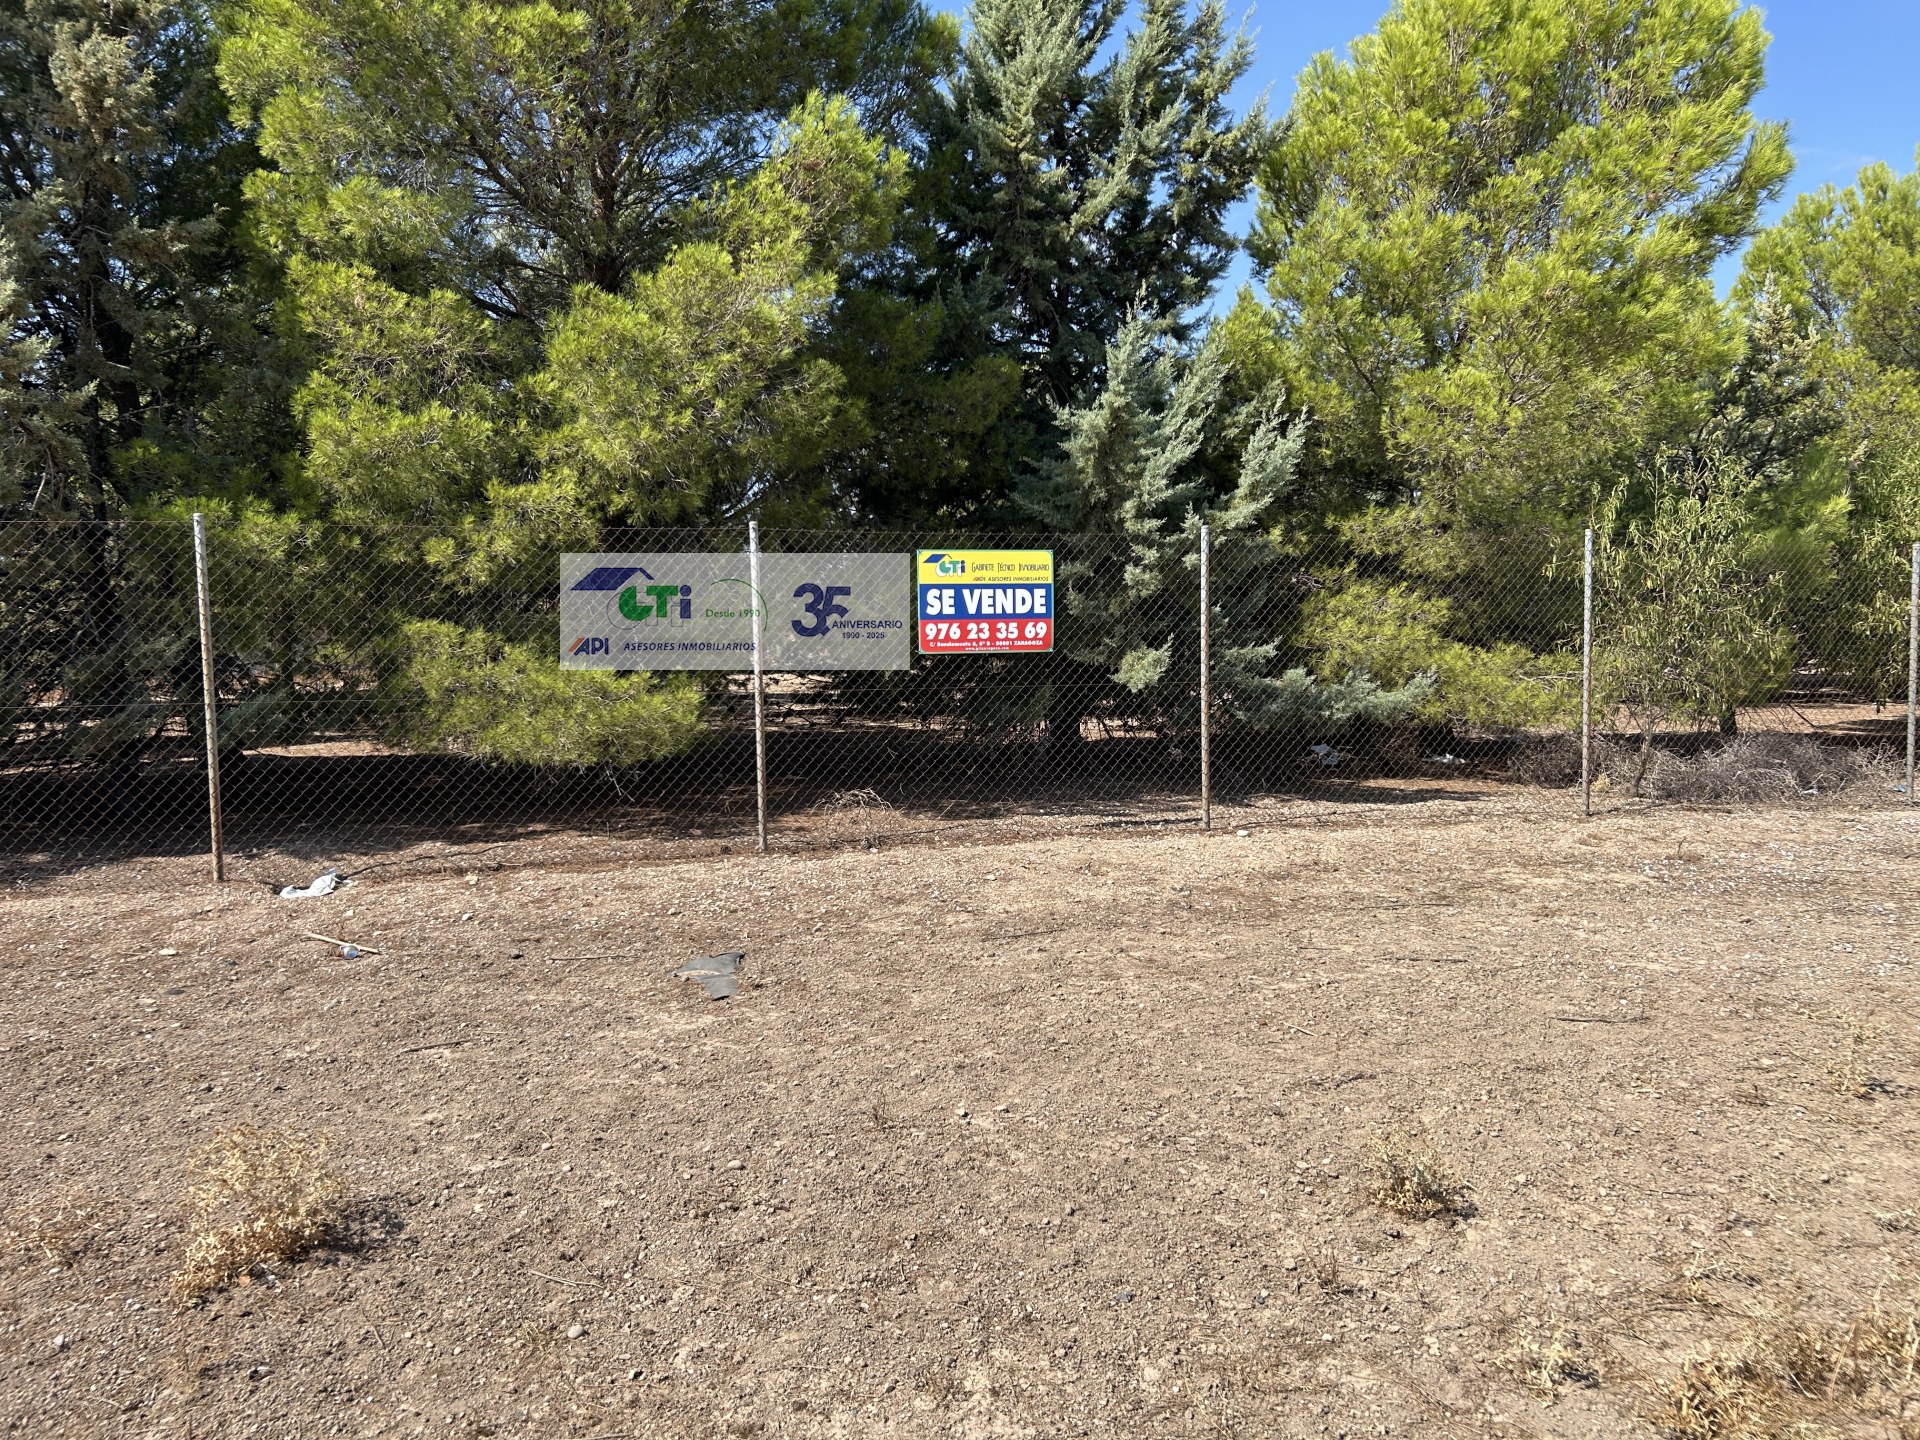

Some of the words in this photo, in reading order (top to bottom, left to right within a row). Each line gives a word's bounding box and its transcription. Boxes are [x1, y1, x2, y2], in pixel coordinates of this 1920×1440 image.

[925, 588, 956, 616] SE
[961, 588, 1047, 615] VENDE
[925, 622, 961, 640] 976
[966, 622, 990, 640] 23
[995, 622, 1019, 639] 35
[1024, 621, 1048, 639] 69
